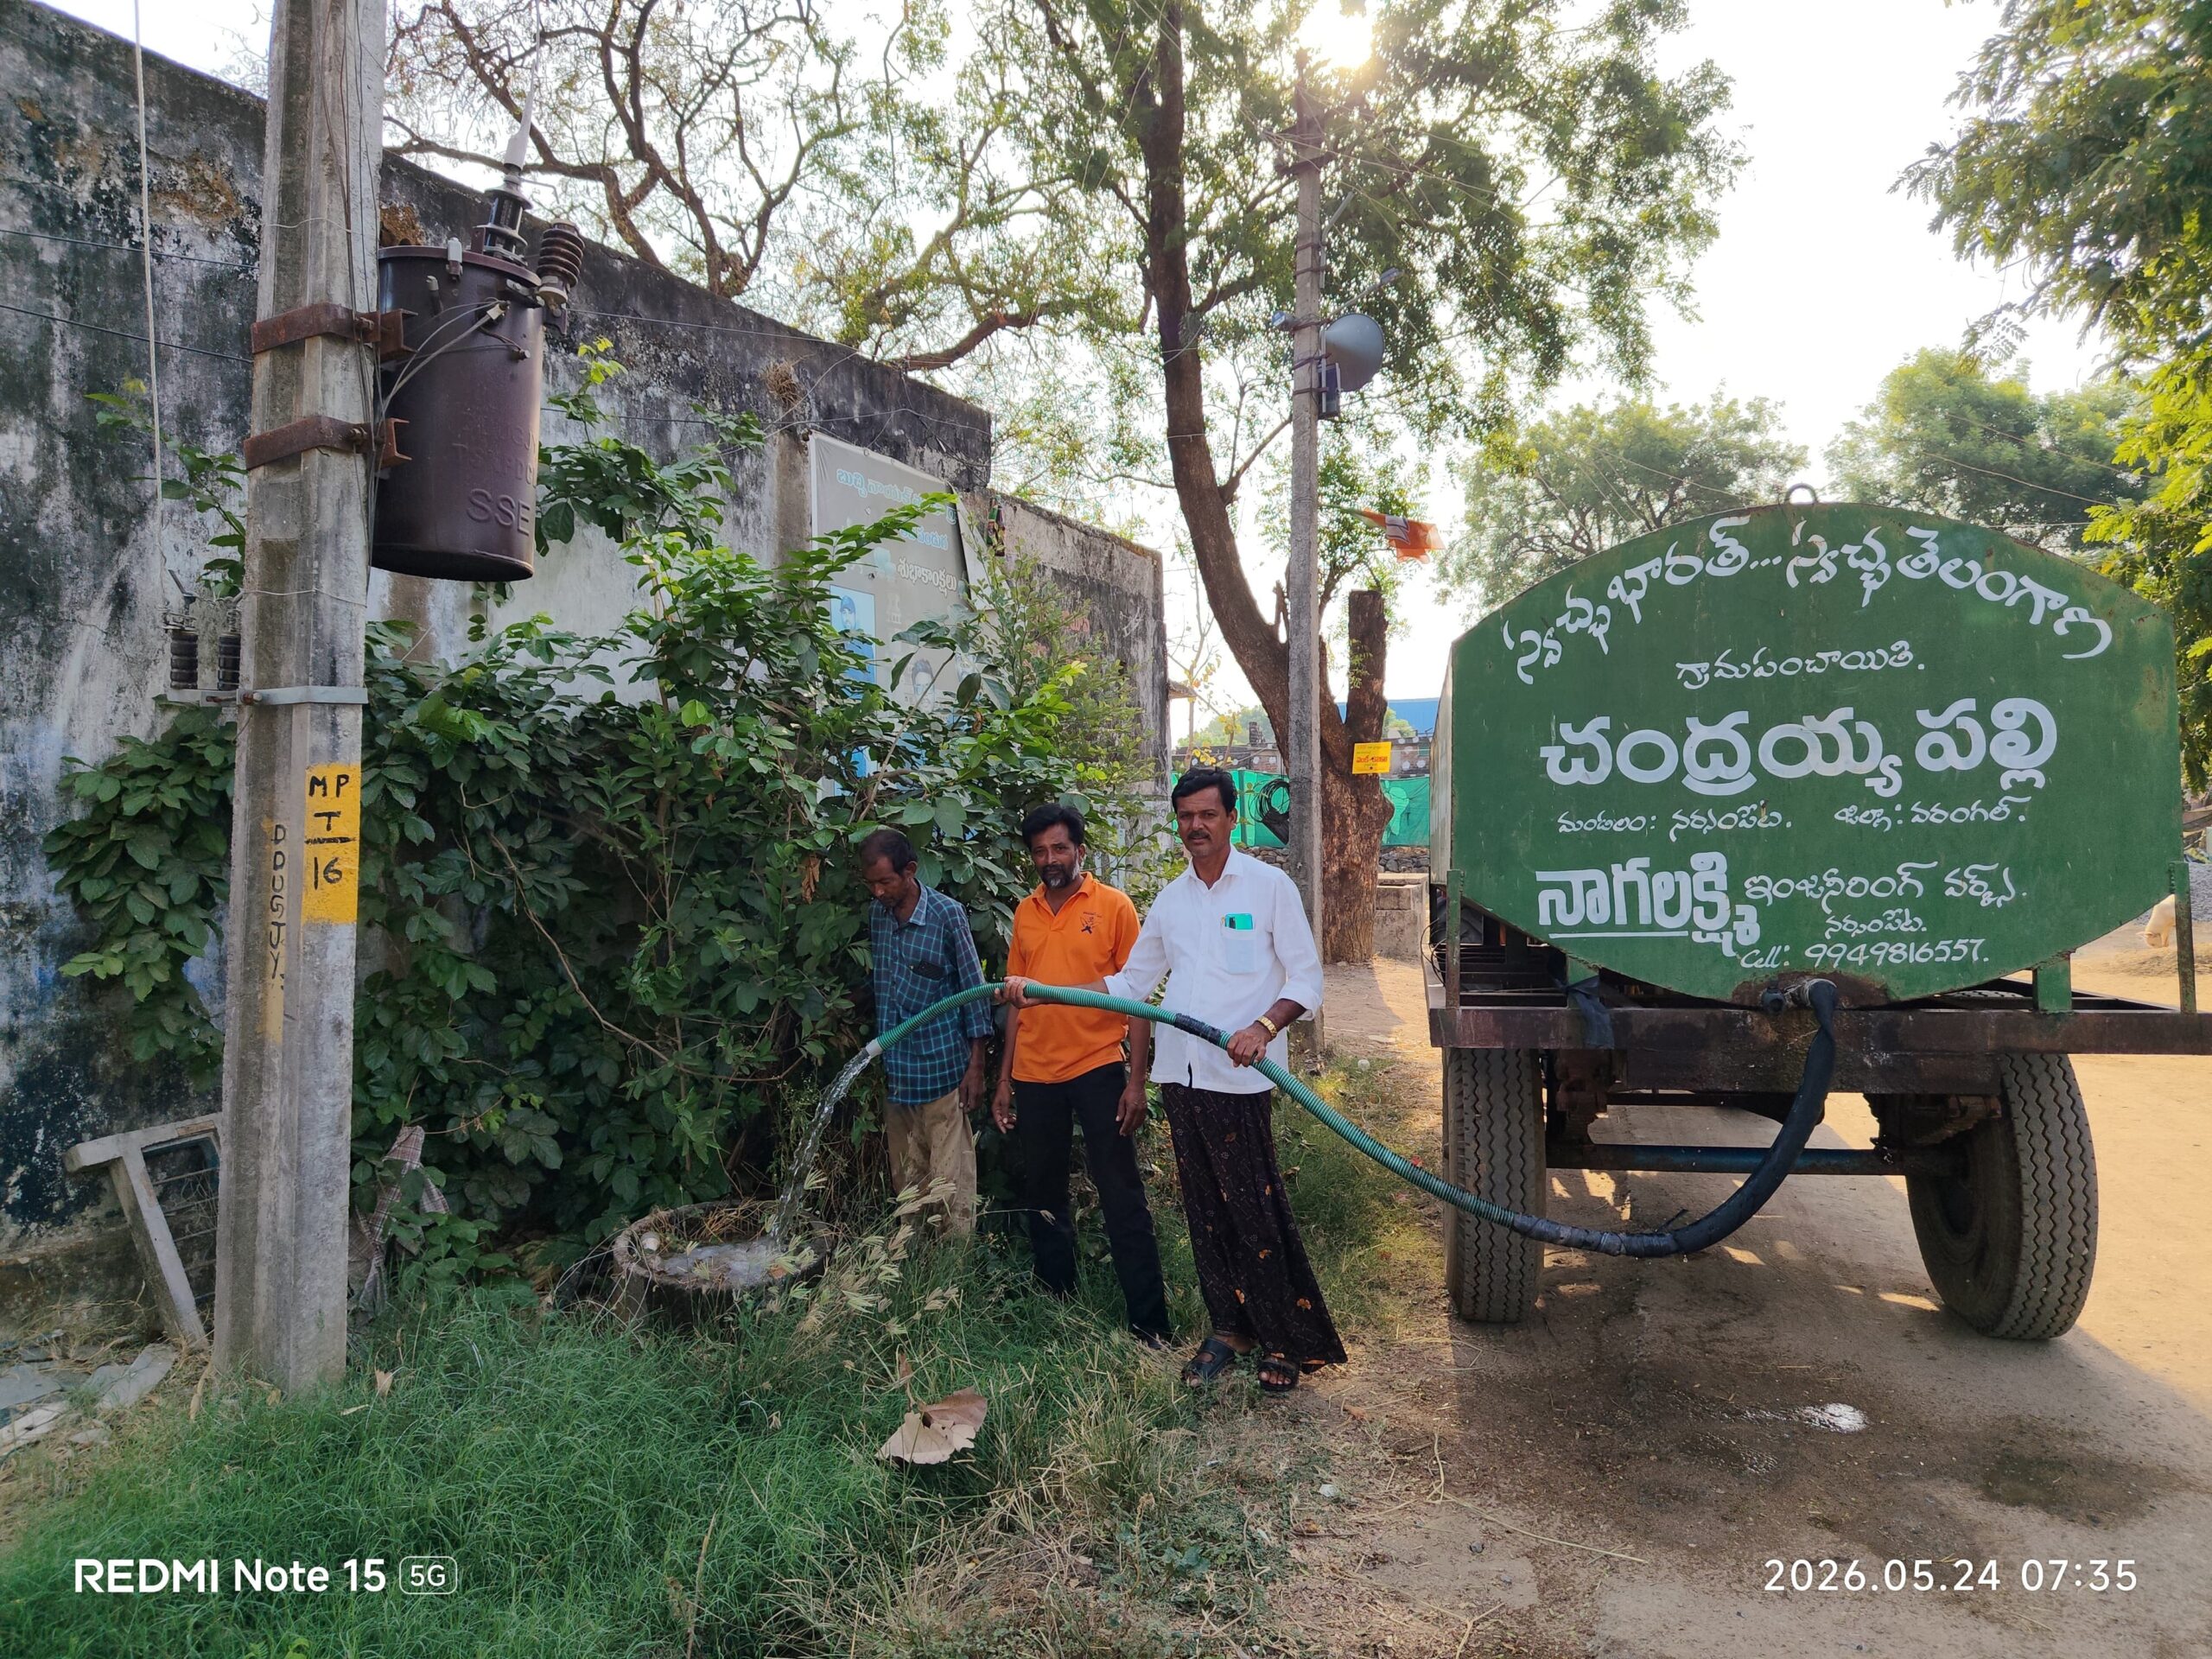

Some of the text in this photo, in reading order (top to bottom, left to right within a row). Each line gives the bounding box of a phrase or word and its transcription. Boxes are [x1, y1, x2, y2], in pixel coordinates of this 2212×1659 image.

[467, 487, 531, 537] SSE
[897, 556, 957, 598] శుభాకాంక్షలు
[1896, 524, 2113, 659] తెలంగాణ
[308, 773, 350, 798] MP
[313, 810, 341, 831] T
[313, 856, 343, 890] 16
[1740, 945, 1790, 969] Cell:
